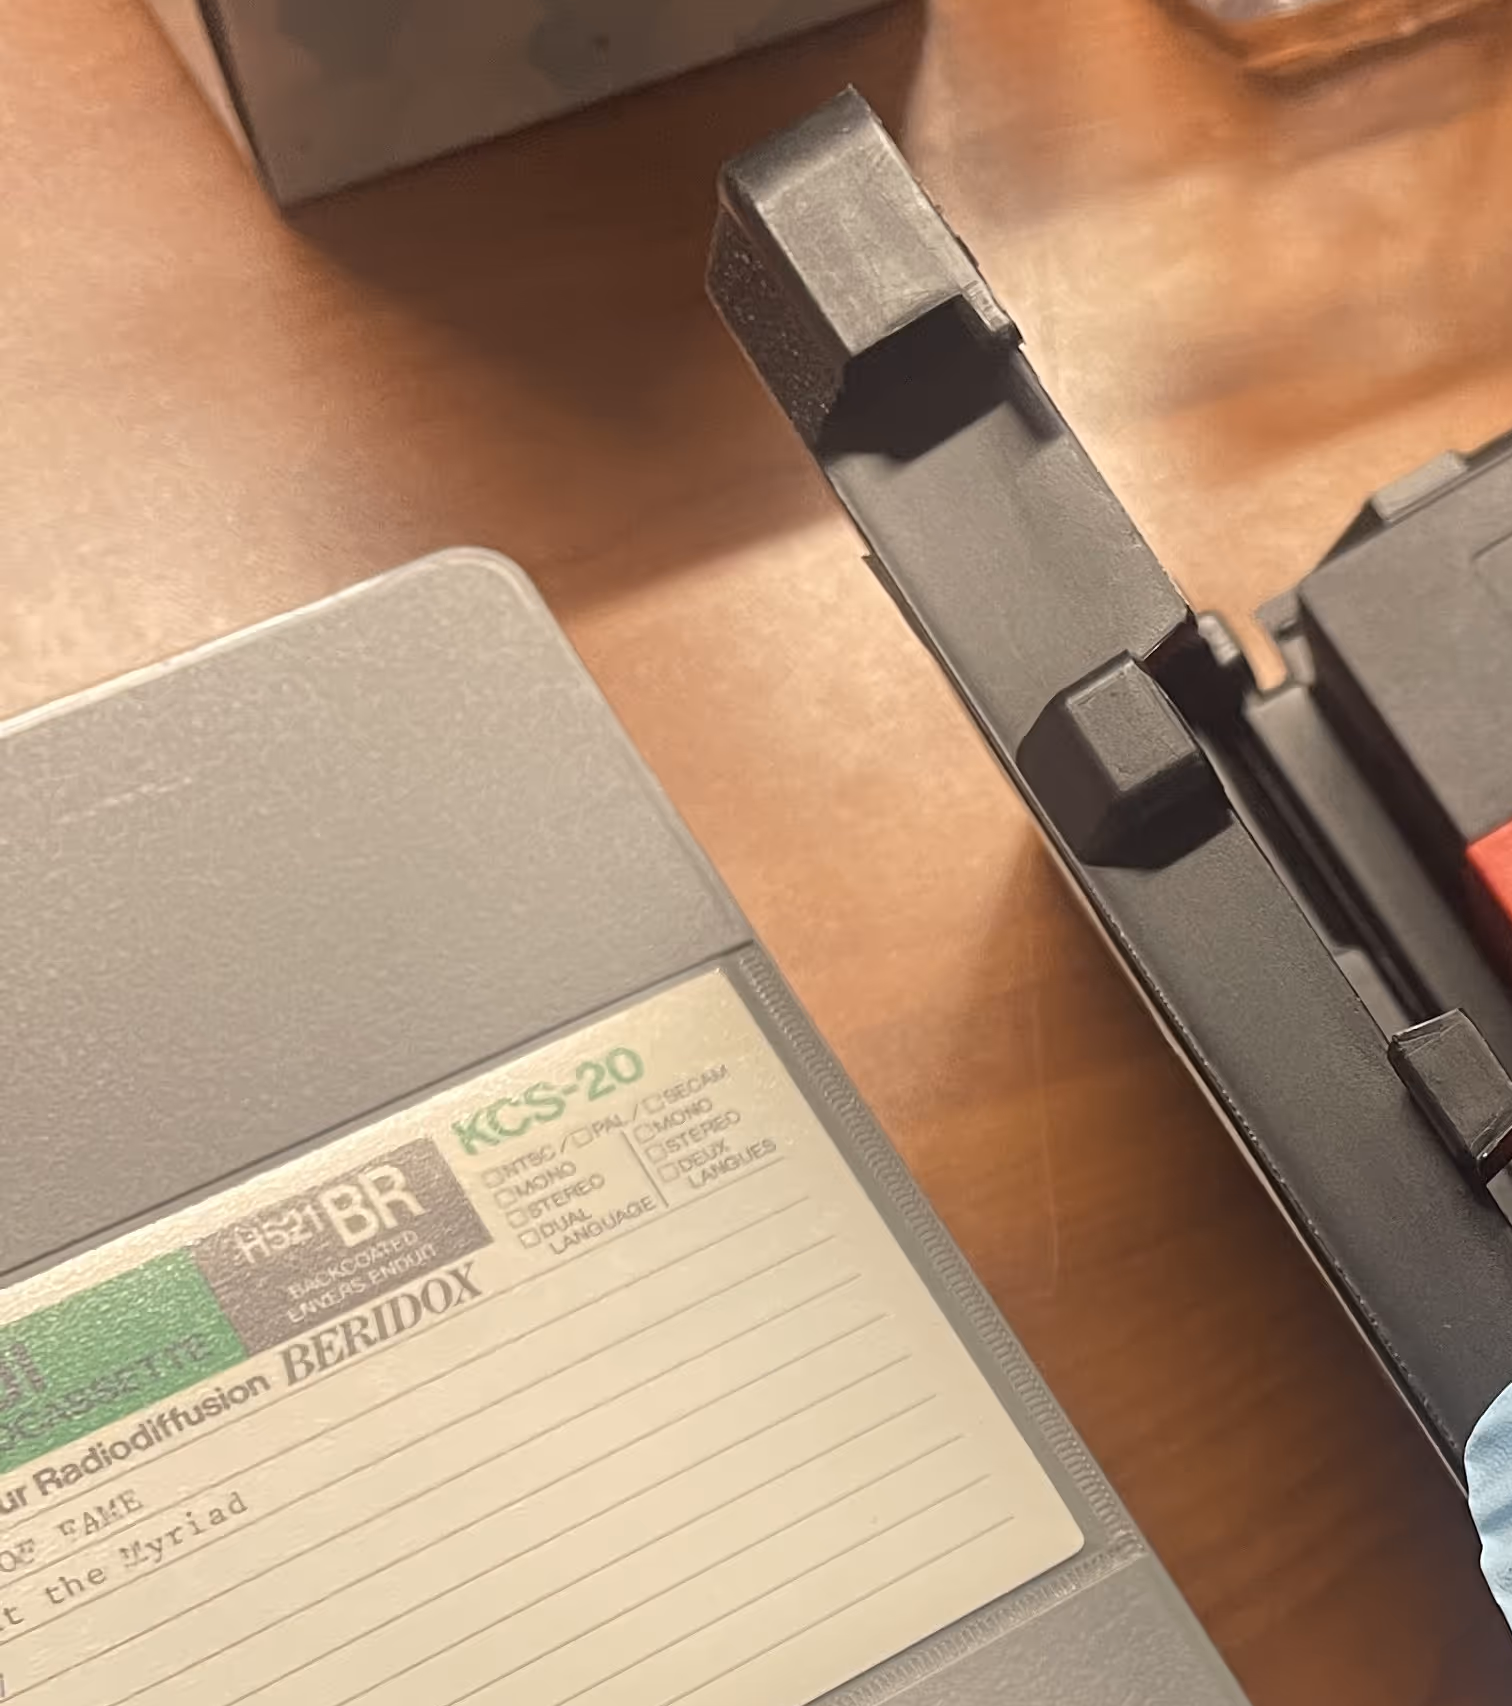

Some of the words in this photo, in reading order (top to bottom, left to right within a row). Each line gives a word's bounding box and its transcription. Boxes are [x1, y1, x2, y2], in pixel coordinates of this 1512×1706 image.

[451, 1047, 644, 1155] KCS-20
[664, 1064, 728, 1104] SECAM
[653, 1098, 713, 1133] MONO
[666, 1110, 741, 1152] STEREO
[515, 1160, 577, 1197] MONO
[679, 1139, 729, 1172] DEUX
[688, 1138, 777, 1189] LANGUES
[528, 1174, 606, 1218] STEREO
[539, 1208, 593, 1238] DUAL
[550, 1196, 656, 1255] LANGUAGE
[288, 1229, 419, 1300] BACKCOATED
[277, 1261, 483, 1386] BERIDOX
[288, 1275, 366, 1323] ENVERS
[33, 1375, 271, 1496] Radiodiffusion
[56, 1488, 144, 1541] FAME
[45, 1567, 107, 1605] the
[119, 1491, 249, 1568] Myriad
